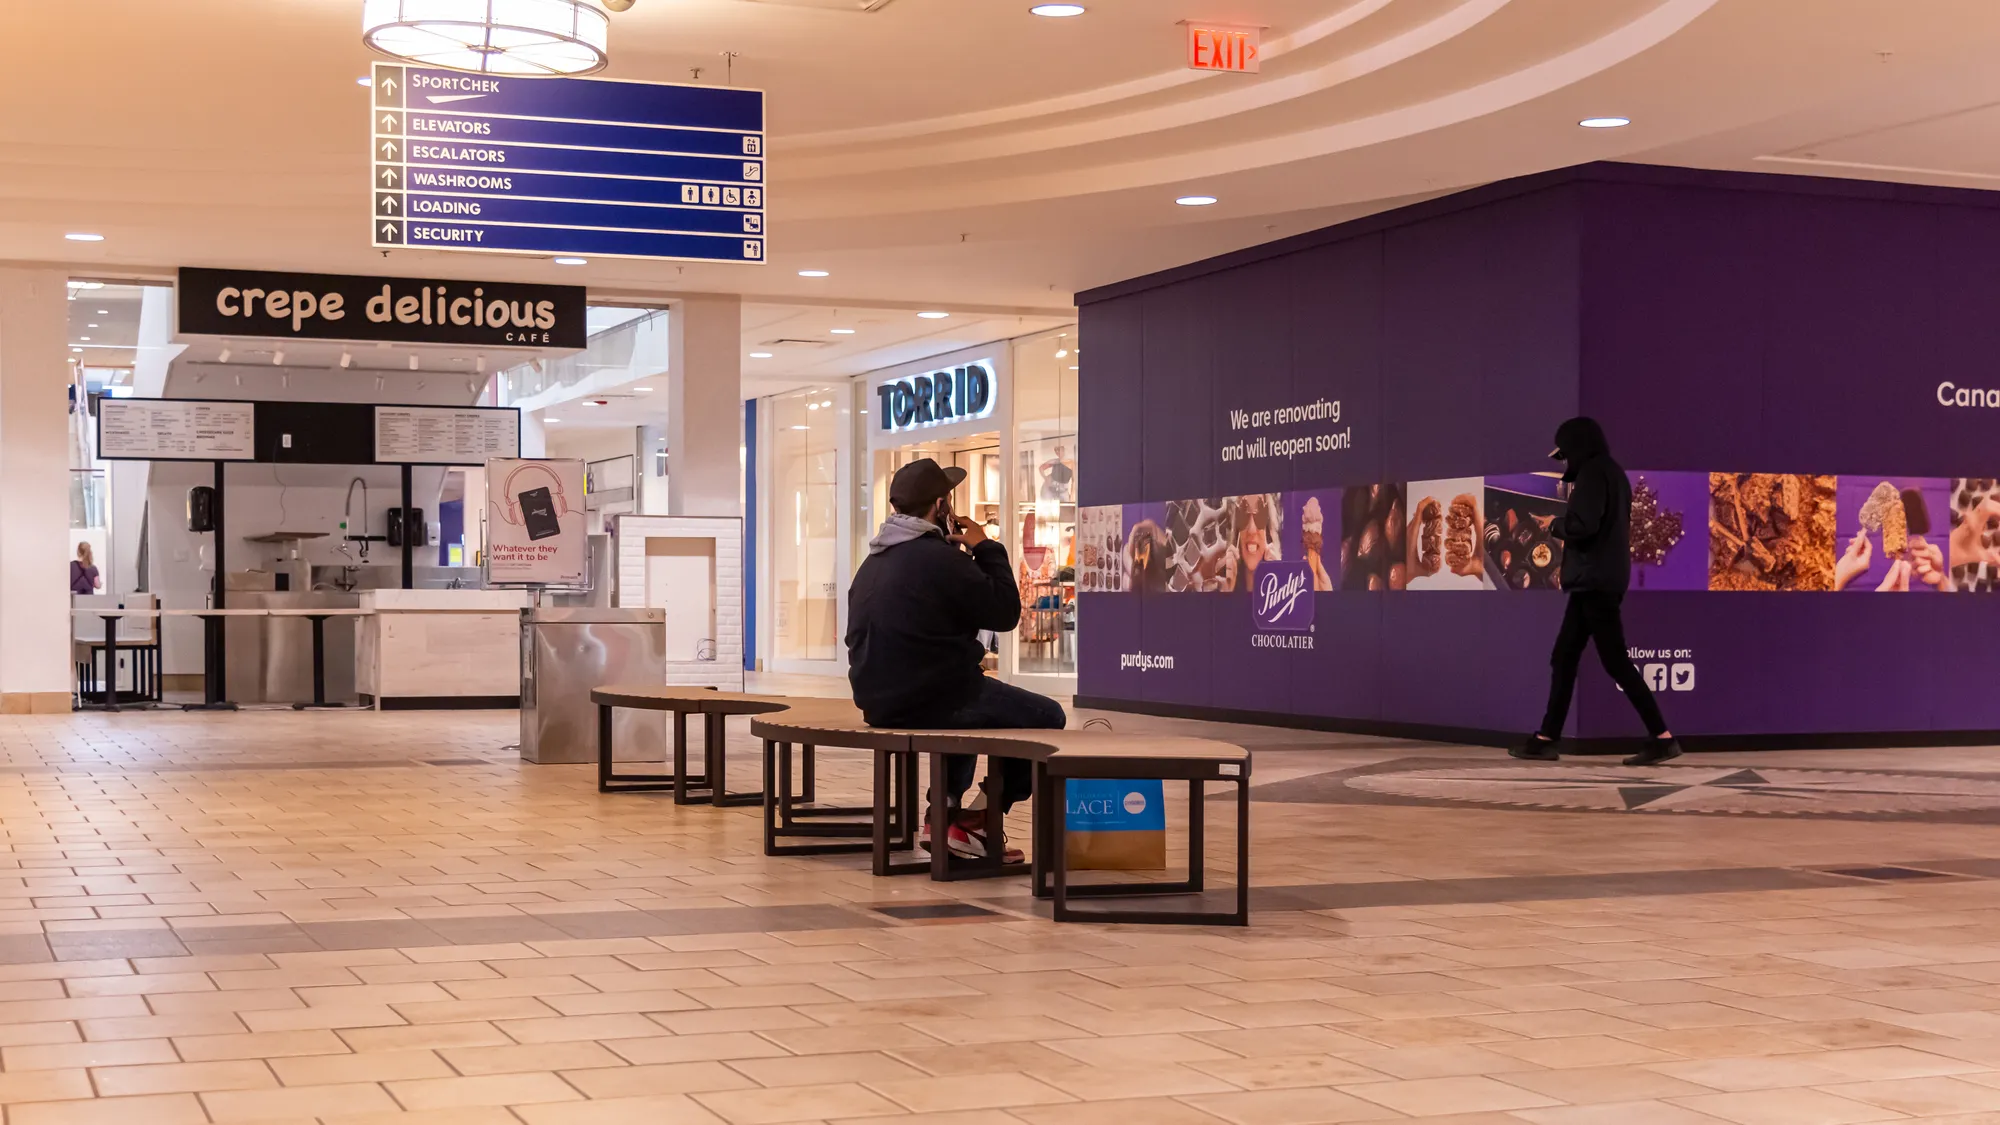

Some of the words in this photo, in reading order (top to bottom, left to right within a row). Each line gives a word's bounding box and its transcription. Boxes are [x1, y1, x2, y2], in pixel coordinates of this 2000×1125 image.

[1194, 29, 1248, 70] EXIT
[413, 118, 491, 135] ELEVATORS
[413, 145, 506, 163] ESCALATORS
[413, 172, 512, 190] WASHROOMS
[413, 200, 481, 215] LOADING
[413, 227, 484, 242] SECURITY
[216, 286, 345, 332] crepe
[365, 284, 556, 330] delicious
[506, 332, 550, 343] CAFÉ
[877, 364, 990, 430] TORRID
[1936, 381, 2000, 408] Cana
[1230, 409, 1249, 430] We
[1251, 410, 1271, 428] are
[1274, 398, 1341, 425] renovating
[1221, 440, 1244, 462] and
[1246, 437, 1267, 459] will
[1269, 437, 1312, 460] reopen
[1315, 426, 1351, 452] soon!
[492, 544, 536, 552] Whatever
[538, 544, 558, 554] they
[1258, 569, 1307, 623] Purdys
[1251, 634, 1314, 650] CHOCOLATIER
[1120, 650, 1174, 672] purdys.com
[1658, 649, 1671, 658] us
[1674, 649, 1692, 658] on:
[1066, 799, 1114, 815] LACE
